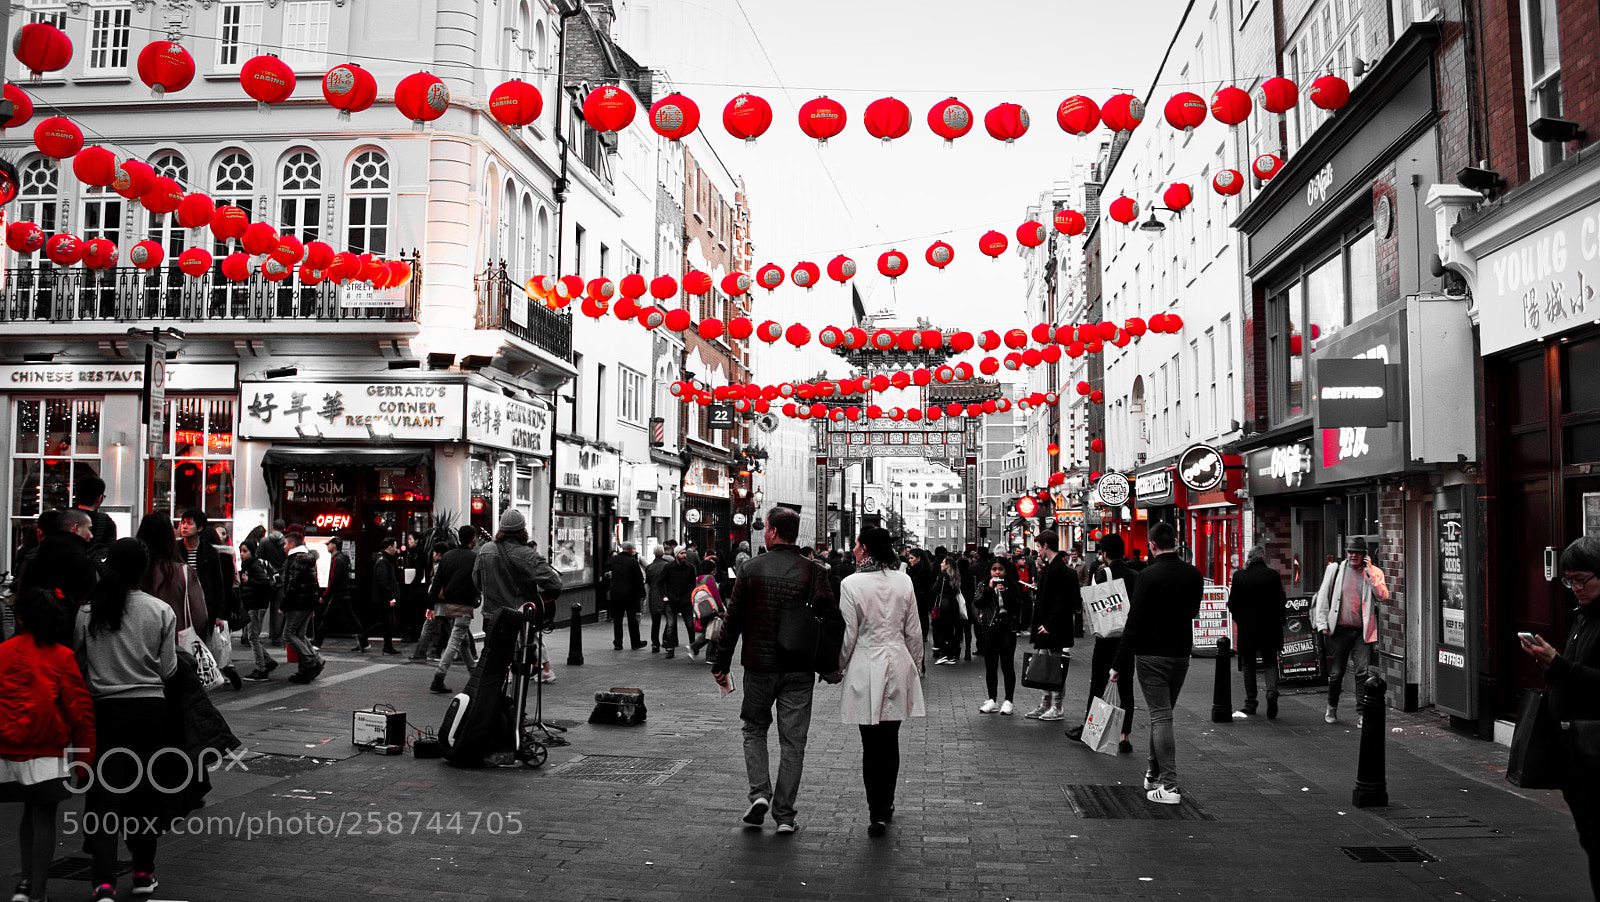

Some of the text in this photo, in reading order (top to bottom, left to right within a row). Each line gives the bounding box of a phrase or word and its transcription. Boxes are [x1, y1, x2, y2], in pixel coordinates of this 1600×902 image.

[254, 74, 285, 85] CASINO
[46, 131, 74, 139] CASINO
[1493, 213, 1600, 296] YOUNG C
[11, 370, 176, 382] CHINESE RESTAURT
[366, 385, 446, 397] GERRARD'S
[1321, 386, 1384, 399] BETFRED
[247, 390, 345, 424] 好年華
[379, 402, 437, 413] CORNER
[714, 410, 728, 420] 22
[294, 483, 344, 493] DIM SUM
[315, 513, 351, 528] OPEN
[1447, 523, 1456, 541] 12
[1444, 541, 1459, 557] BEST
[1444, 557, 1461, 573] ODDS
[1209, 593, 1225, 601] RISE
[1284, 599, 1309, 611] Neill's
[1199, 611, 1222, 619] SPIRITS
[1199, 620, 1223, 628] LOTTERY
[1194, 629, 1228, 637] SOFT DRINKS
[1438, 649, 1465, 668] BETFRED
